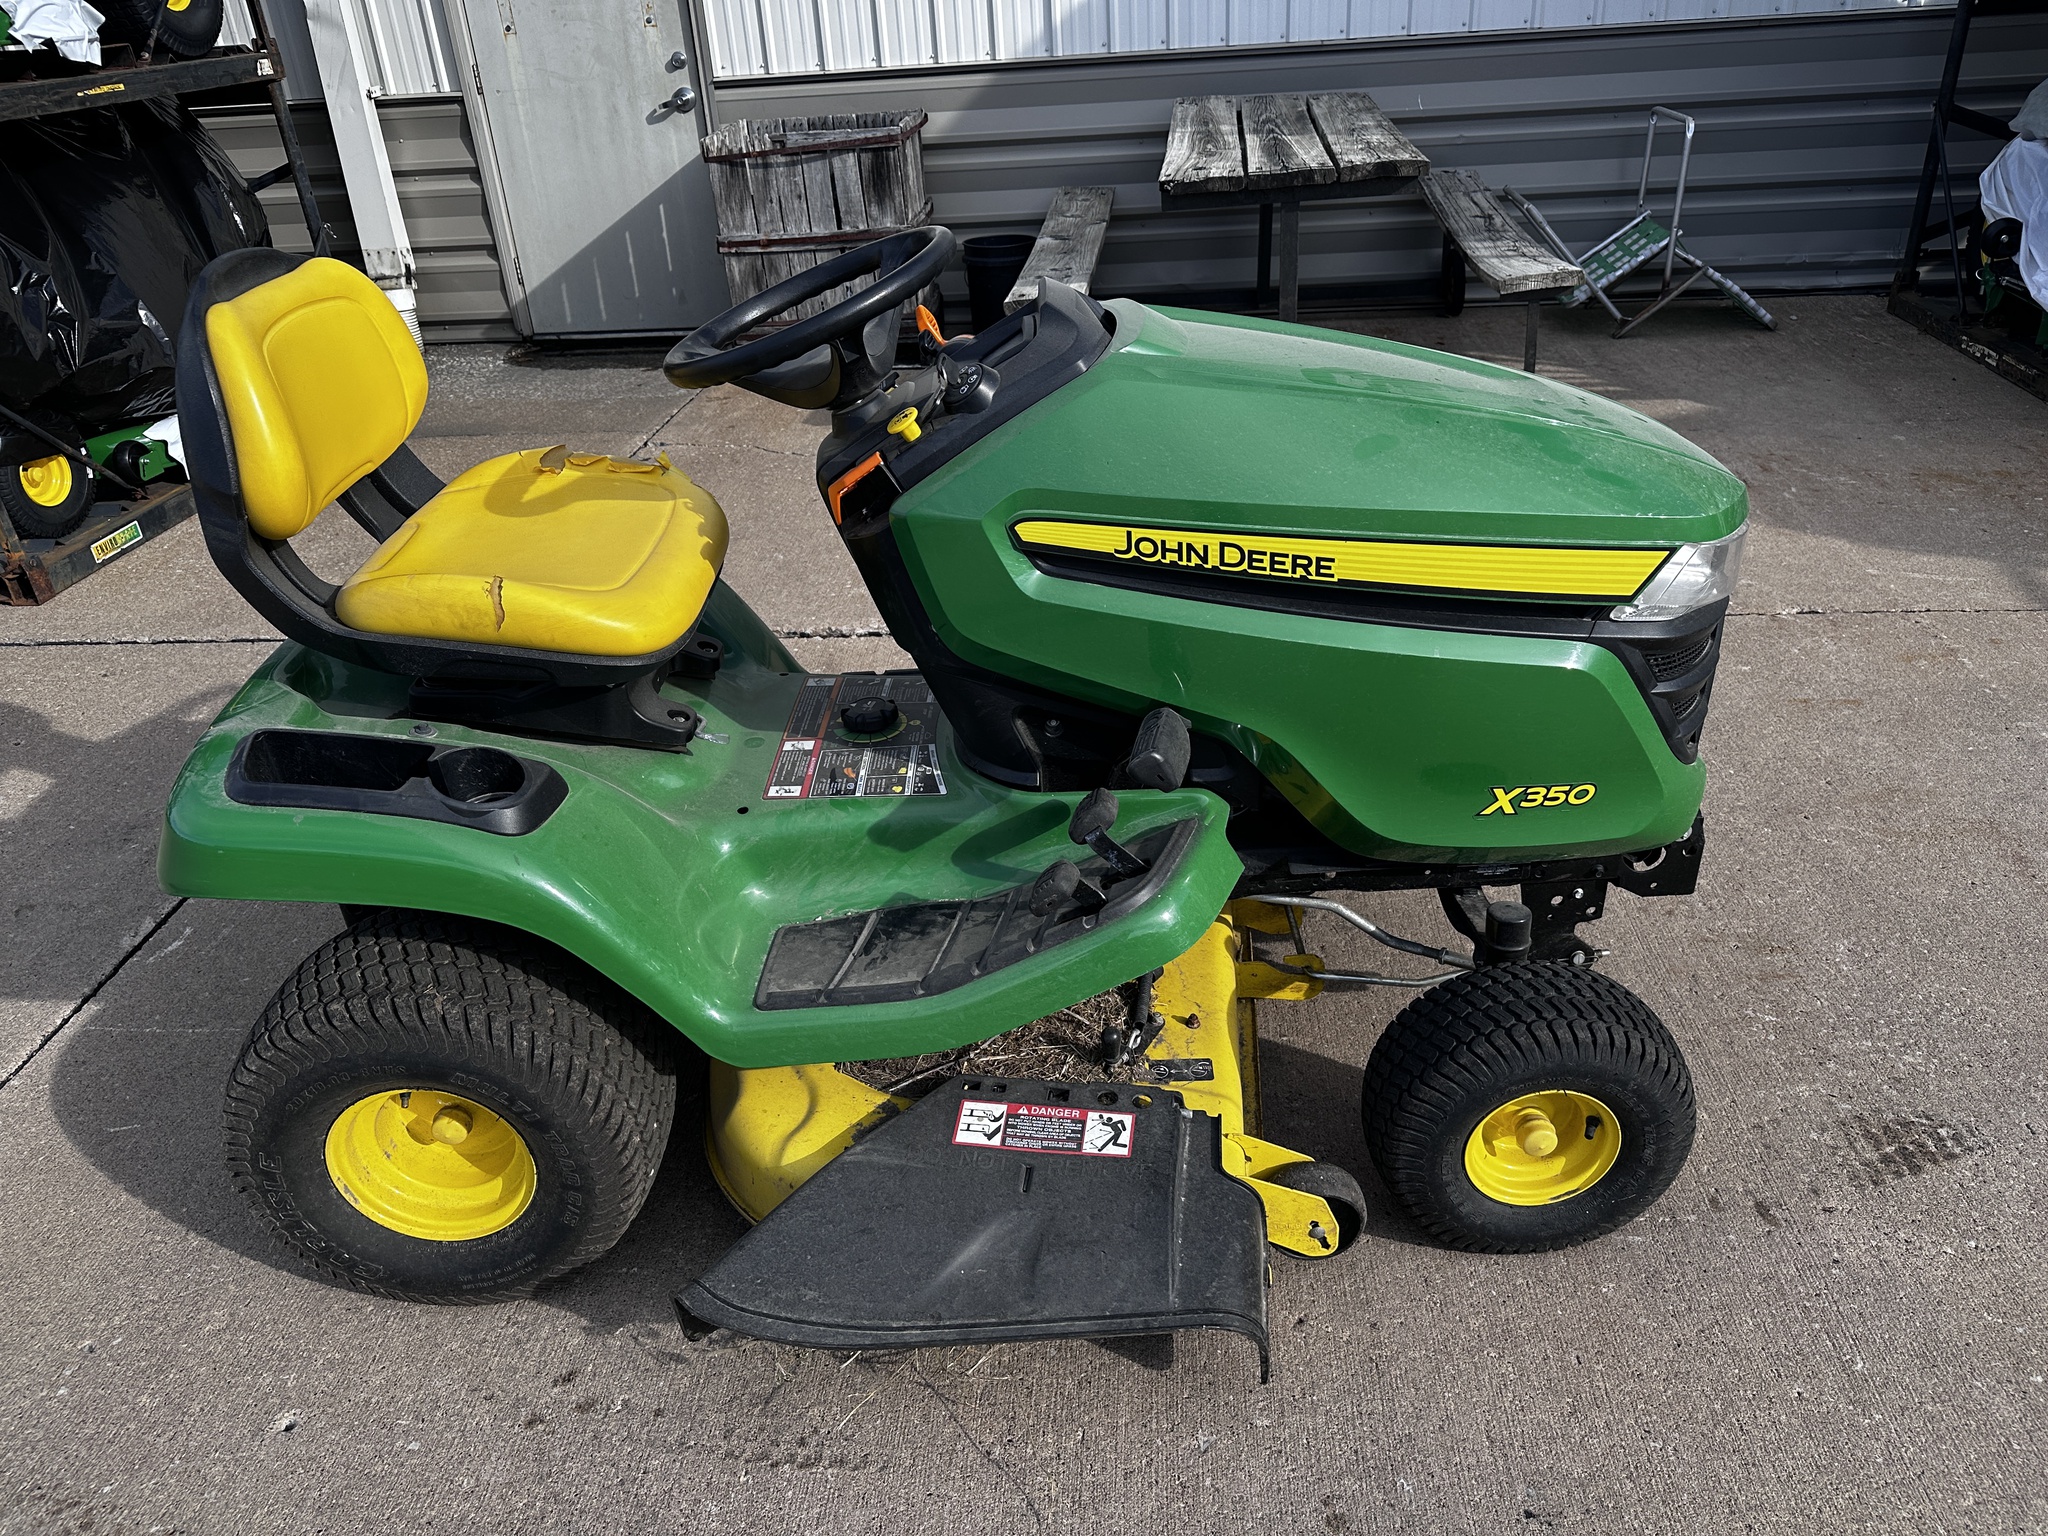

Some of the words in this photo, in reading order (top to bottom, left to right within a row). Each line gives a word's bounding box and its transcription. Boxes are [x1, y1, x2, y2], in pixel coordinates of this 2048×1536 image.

[1114, 530, 1210, 566] JOHN
[1218, 541, 1336, 579] DEERE
[1477, 783, 1596, 816] X350
[451, 1072, 541, 1122] MULTI
[543, 1130, 581, 1187] TRAC
[1031, 1106, 1080, 1118] DANGER
[259, 1152, 384, 1279] CARLISLE
